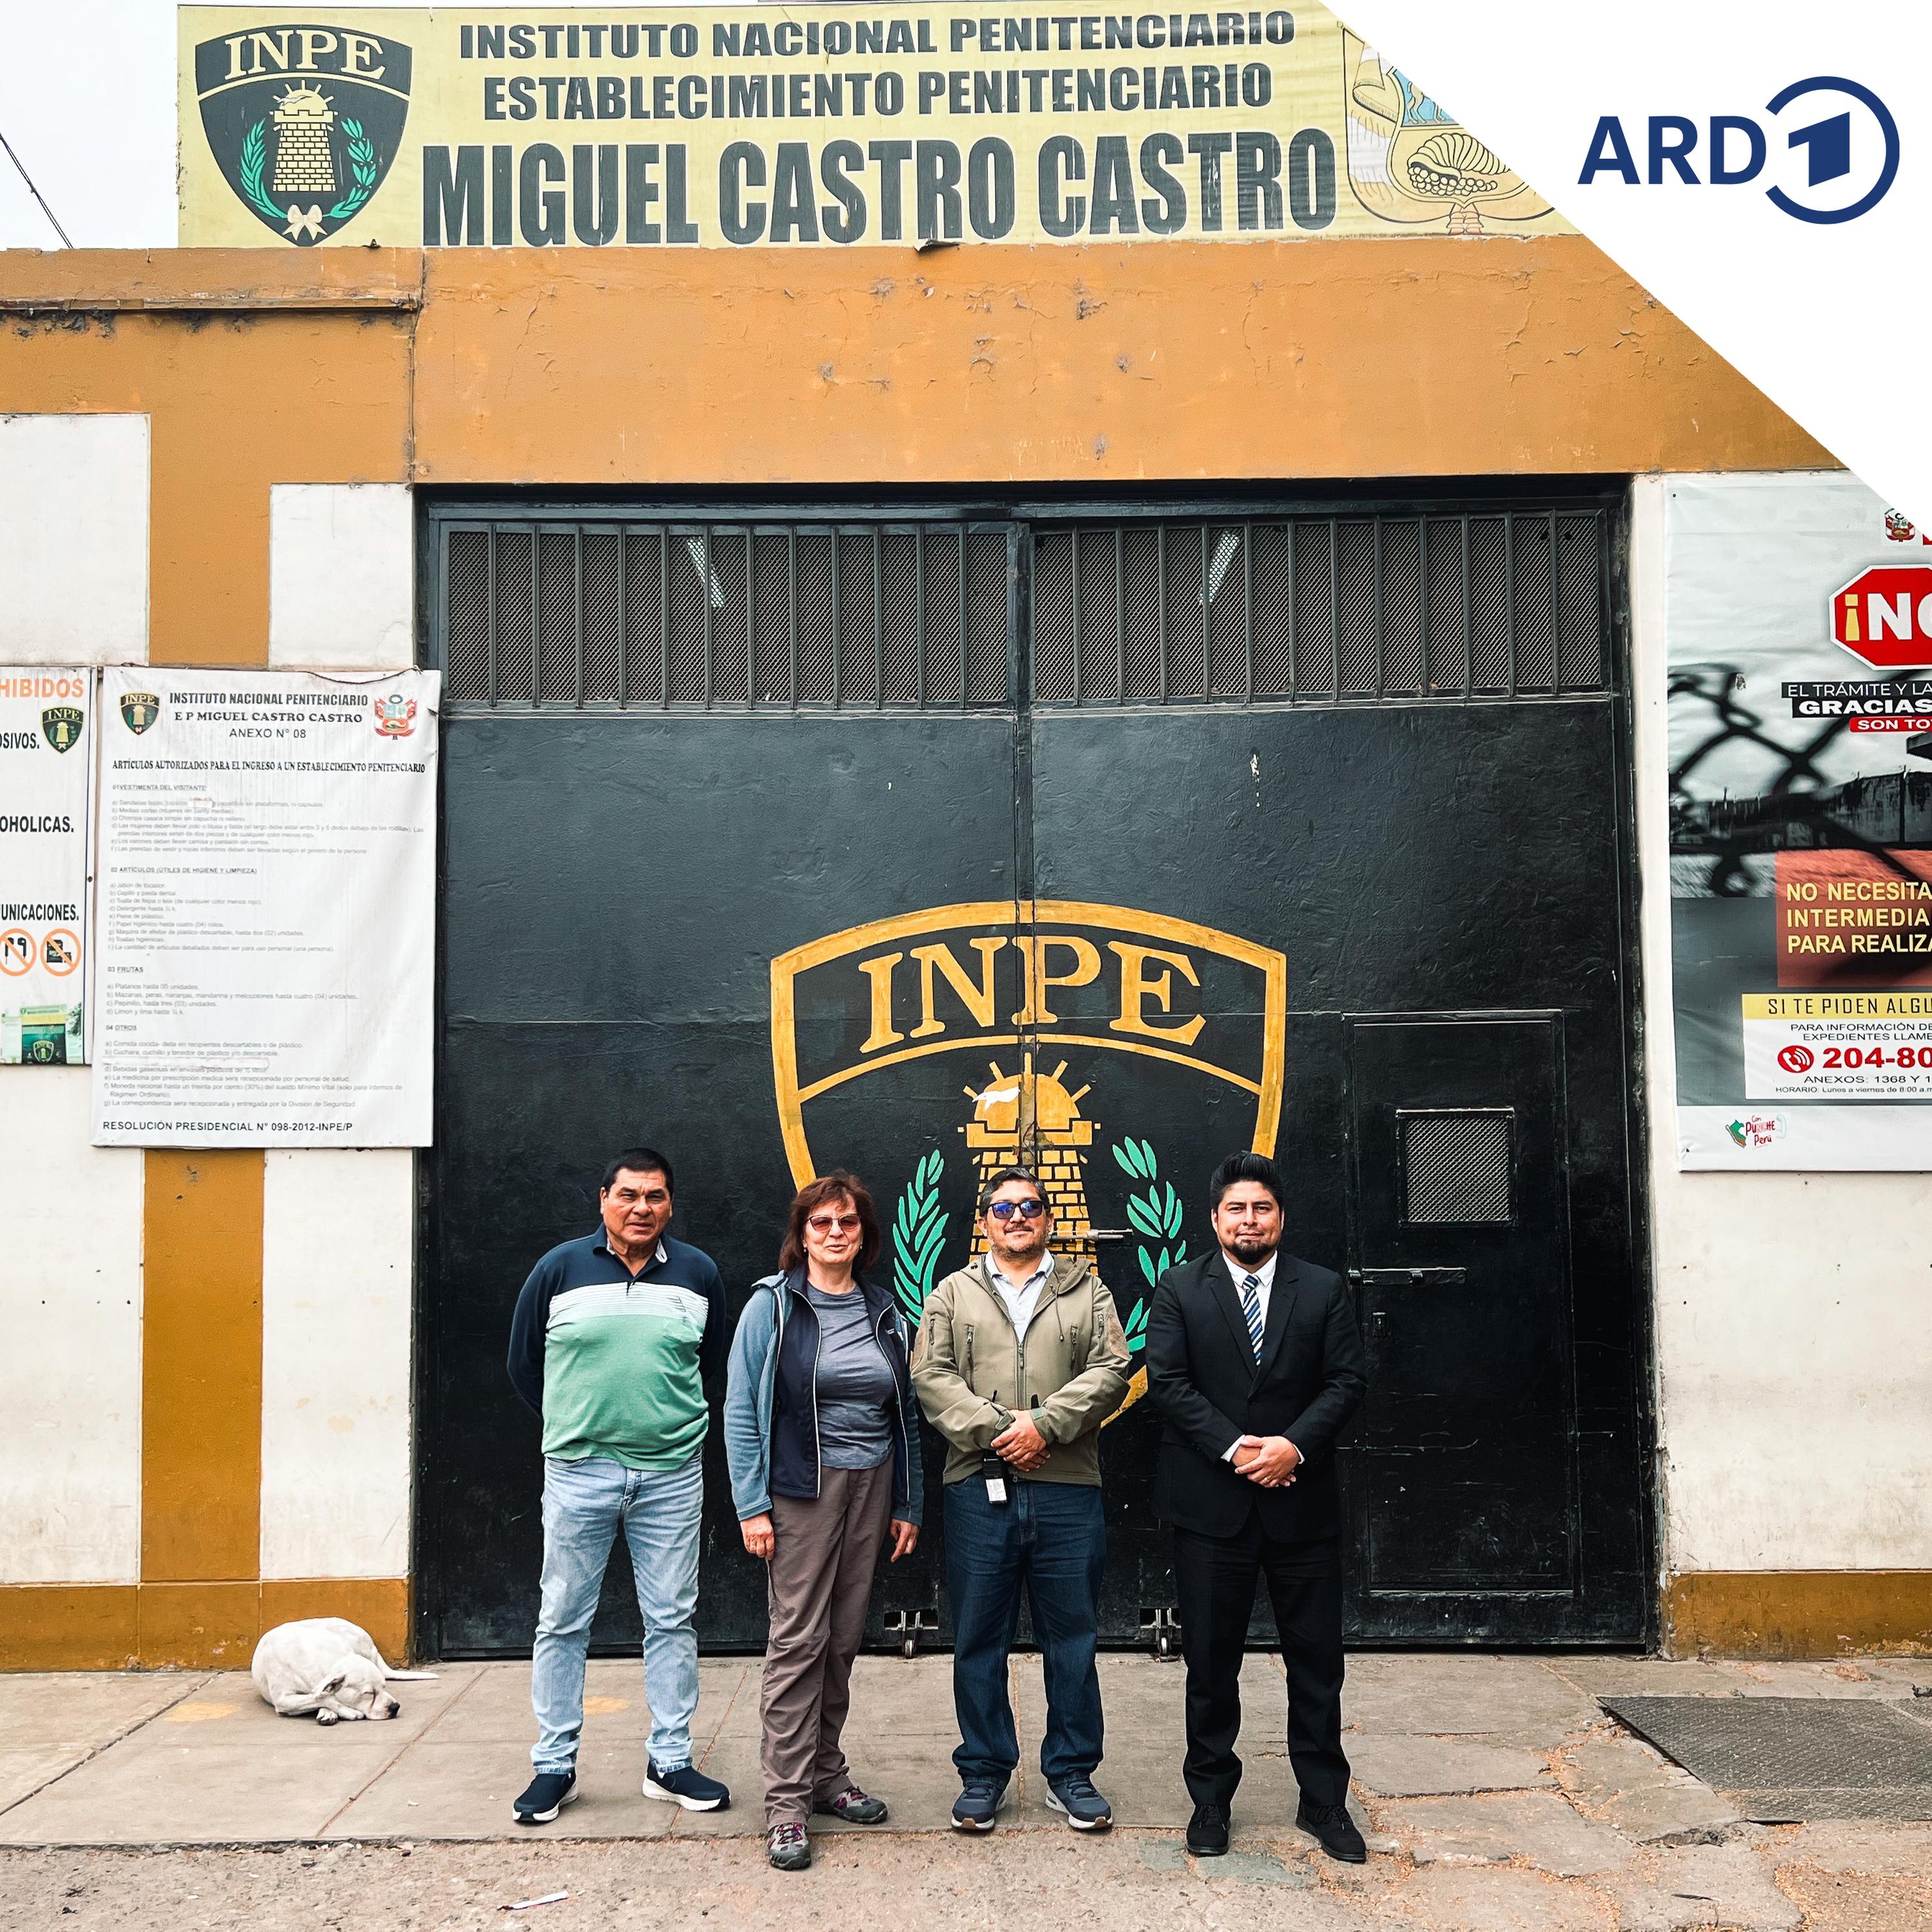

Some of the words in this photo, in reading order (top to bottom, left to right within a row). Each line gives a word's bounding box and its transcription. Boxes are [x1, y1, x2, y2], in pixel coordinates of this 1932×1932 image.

[460, 24, 699, 59] INSTITUTO
[714, 15, 937, 57] NACIONAL
[949, 12, 1295, 53] PENITENCIARIO
[223, 30, 387, 82] INPE
[484, 70, 904, 122] ESTABLECIMIENTO
[918, 62, 1272, 116] PENITENCIARIO
[422, 142, 699, 247] MIGUEL
[719, 134, 1016, 245] CASTRO
[1036, 129, 1337, 241] CASTRO
[1788, 685, 1809, 697] EL
[1813, 681, 1891, 696] TRÁMITE
[1895, 683, 1907, 695] Y
[125, 695, 155, 705] INPE
[169, 693, 225, 704] INSTITUTO
[229, 694, 283, 705] NACIONAL
[287, 694, 368, 706] PENITENCIARIO
[1799, 699, 1932, 715] GRACIAS
[48, 708, 80, 719] INPE
[175, 712, 182, 721] E
[186, 712, 193, 721] P
[197, 712, 248, 721] MIGUEL
[252, 713, 305, 721] CASTRO
[309, 714, 362, 723] CASTRO
[229, 728, 272, 737] ANEXO
[294, 730, 306, 738] 08
[1858, 720, 1899, 730] SON
[156, 761, 208, 770] AUTORIZADOS
[211, 761, 229, 770] PARA
[242, 762, 275, 770] INGRESO
[285, 762, 295, 770] UN
[298, 762, 366, 772] ESTABLECIMIENTO
[368, 762, 425, 773] PENITENCIARIO
[0, 816, 74, 833] OHOLICAS.
[1786, 883, 1818, 902] NO
[1828, 882, 1932, 901] NECESITA
[1, 904, 79, 920] UNICACIONES.
[1788, 908, 1929, 927] INTERMEDIA
[1788, 934, 1846, 953] PARA
[858, 936, 1207, 1054] INPE
[1769, 999, 1785, 1014] SI
[1794, 999, 1814, 1014] TE
[1823, 998, 1877, 1014] PIDEN
[1823, 1047, 1932, 1068] 204-80
[103, 1120, 172, 1130] RESOLUCIÓN
[176, 1122, 253, 1131] PRESIDENCIAL
